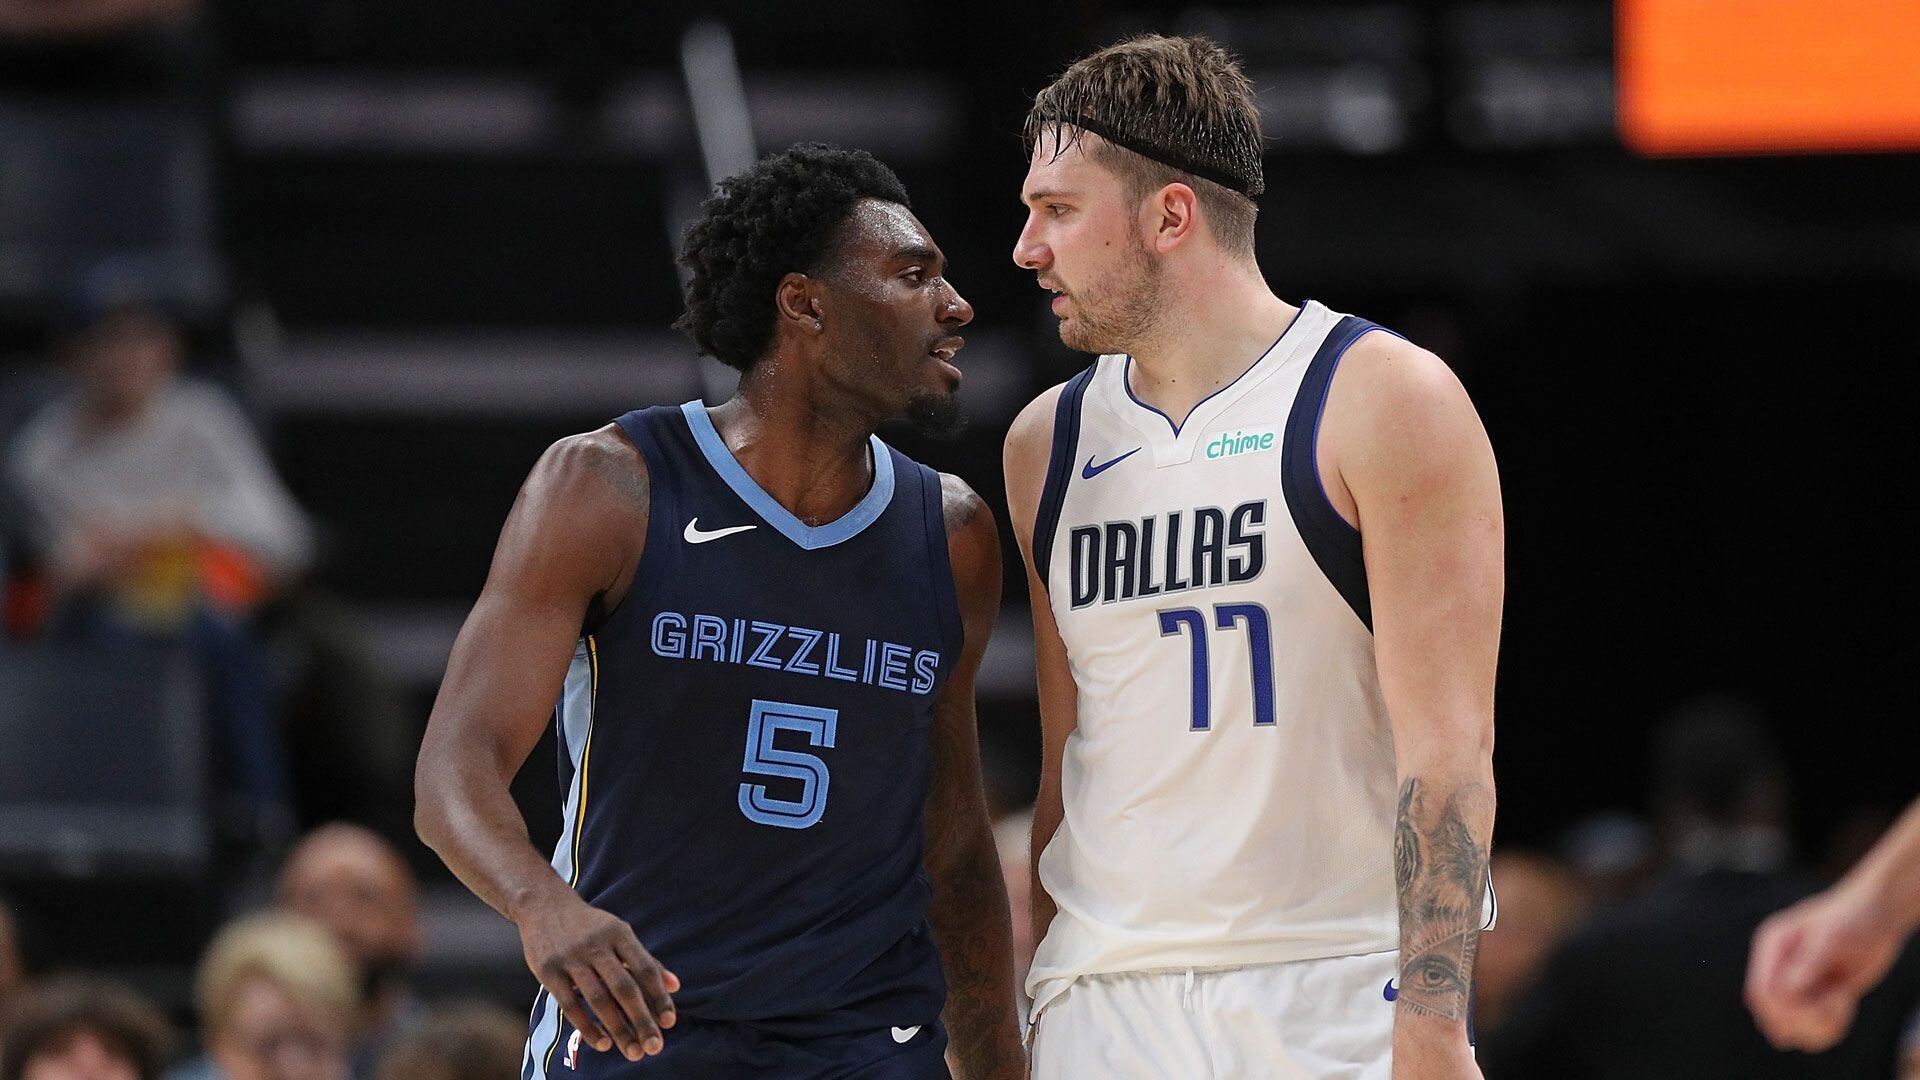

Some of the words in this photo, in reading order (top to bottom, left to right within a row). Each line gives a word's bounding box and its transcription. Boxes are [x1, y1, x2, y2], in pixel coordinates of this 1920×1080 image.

[1206, 430, 1274, 459] chime
[1070, 499, 1267, 611] DALLAS
[650, 611, 940, 695] GRIZZLIES
[1156, 601, 1277, 732] 77
[738, 699, 839, 829] 5
